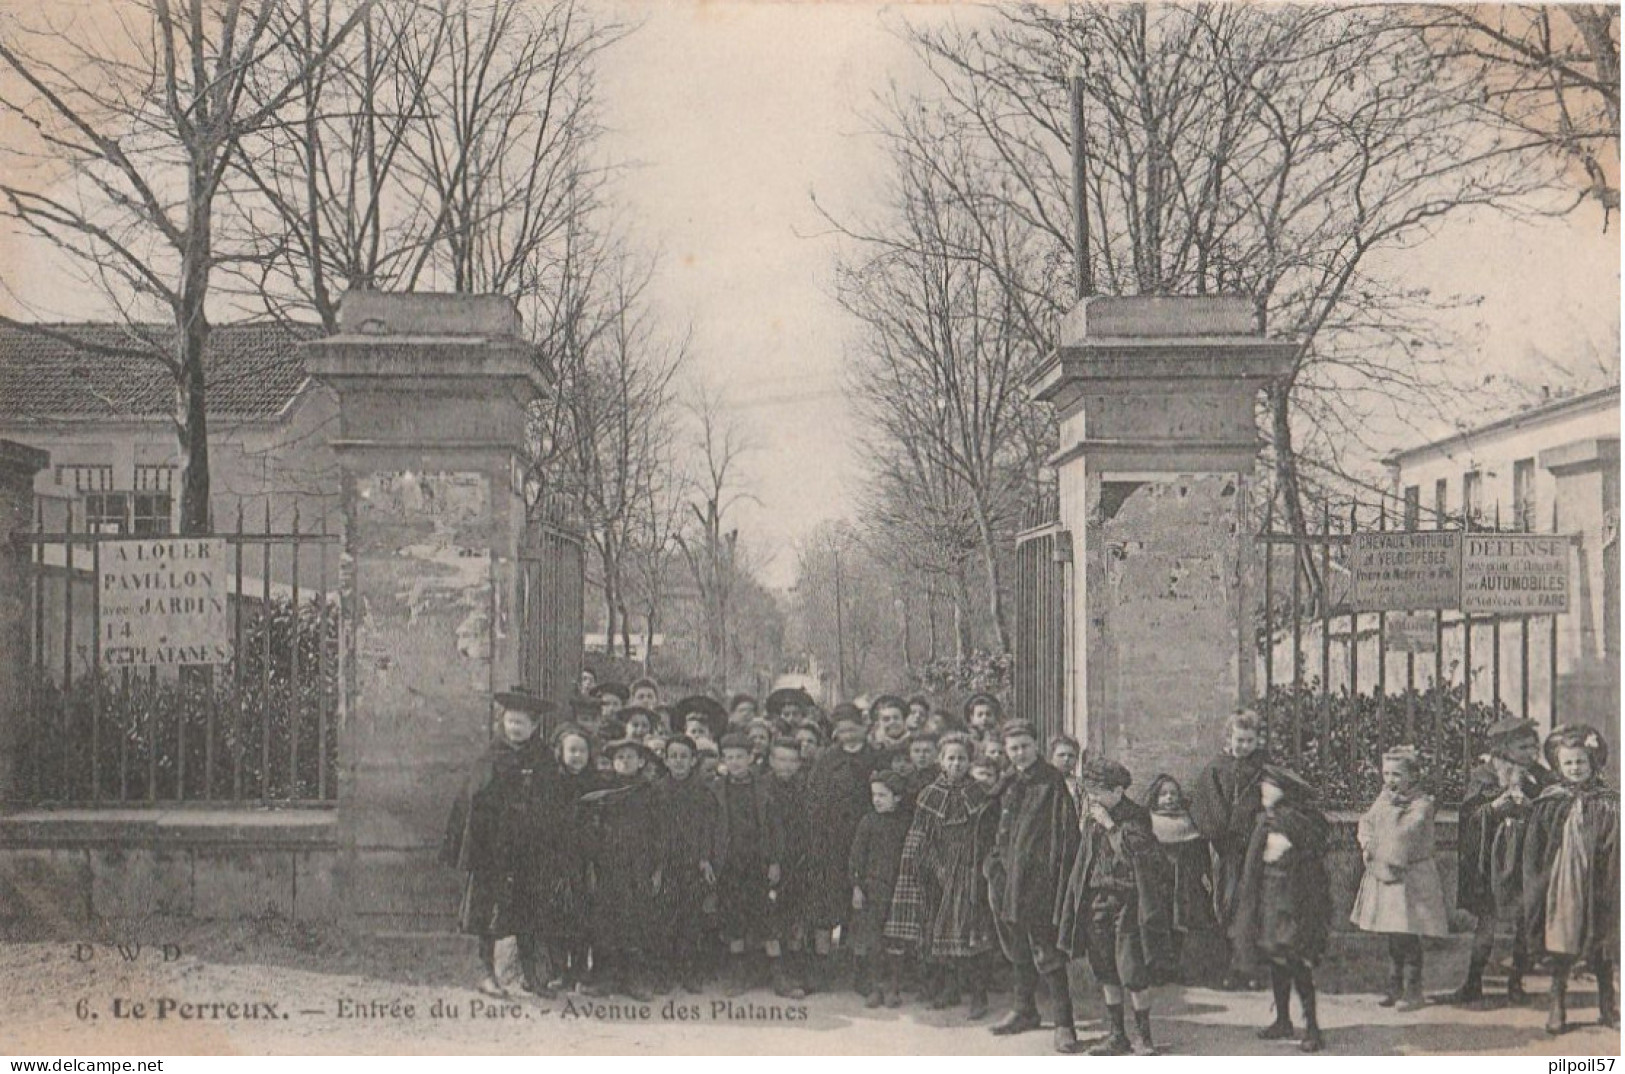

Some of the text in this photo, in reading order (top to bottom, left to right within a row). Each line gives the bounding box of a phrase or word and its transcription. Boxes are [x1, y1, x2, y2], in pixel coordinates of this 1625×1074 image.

[116, 542, 210, 561] A LOUER
[104, 571, 213, 590] PAVILLON
[1480, 576, 1565, 591] AUTOMOBILES
[139, 597, 222, 615] JARDIN
[1538, 593, 1565, 607] PARC
